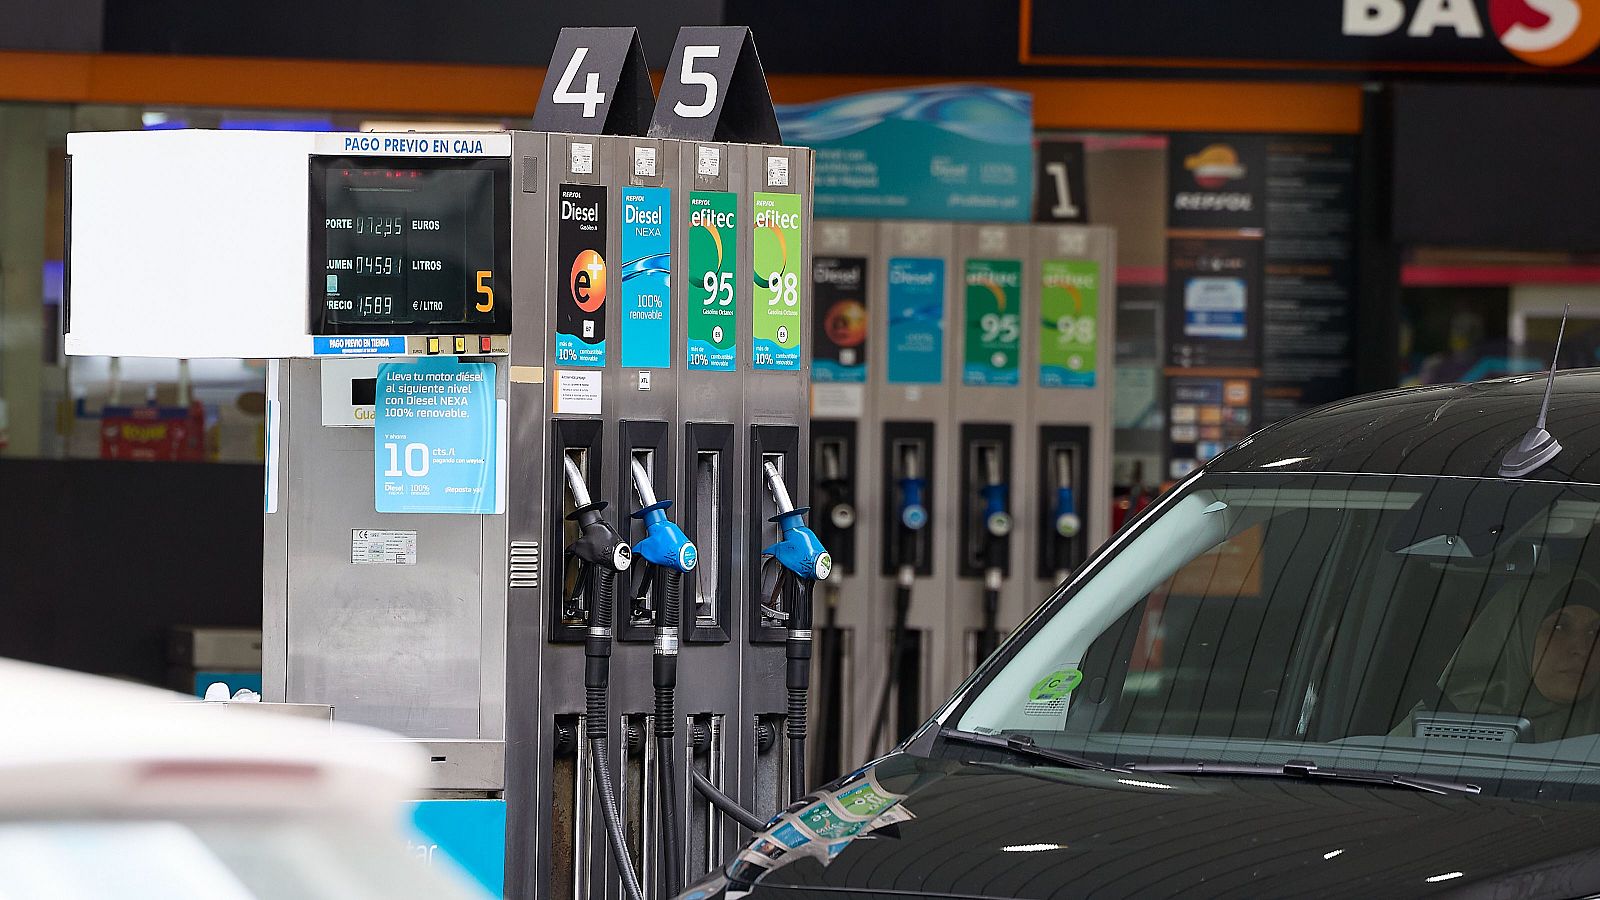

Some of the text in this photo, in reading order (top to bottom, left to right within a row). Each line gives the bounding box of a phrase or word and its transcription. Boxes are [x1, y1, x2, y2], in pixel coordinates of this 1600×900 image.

[553, 47, 606, 118] 4
[673, 45, 721, 118] 5
[345, 138, 483, 154] PAGO PREVIO EN CAJA
[562, 191, 582, 199] REPSOL
[1046, 162, 1079, 218] 1
[1174, 192, 1253, 211] REPSOL
[561, 200, 599, 222] Diesel
[625, 205, 662, 225] Diesel
[412, 220, 440, 231] EUROS
[691, 209, 735, 229] efitec
[756, 210, 799, 229] efitec
[635, 227, 662, 237] NEXA
[326, 259, 353, 270] UMEN
[412, 260, 442, 271] LITROS
[475, 270, 494, 313] 5
[703, 271, 734, 306] 95
[768, 271, 798, 307] 98
[637, 294, 663, 308] 100%
[629, 310, 663, 320] renovable
[980, 313, 1020, 343] 95
[1057, 314, 1096, 345] 98
[329, 338, 390, 348] PAGO PREVIO EN TIENDA
[558, 348, 578, 360] 10%
[690, 354, 709, 366] 10%
[756, 353, 774, 365] 10%
[386, 371, 484, 382] Lleva tu motor diésel
[386, 384, 472, 396] al siguiente nivel
[385, 396, 468, 406] con Diesel NEXA
[385, 408, 470, 419] 100% renovable.
[384, 442, 430, 477] 10
[384, 484, 404, 492] Diesel
[411, 484, 430, 492] 100%
[1048, 679, 1061, 689] C
